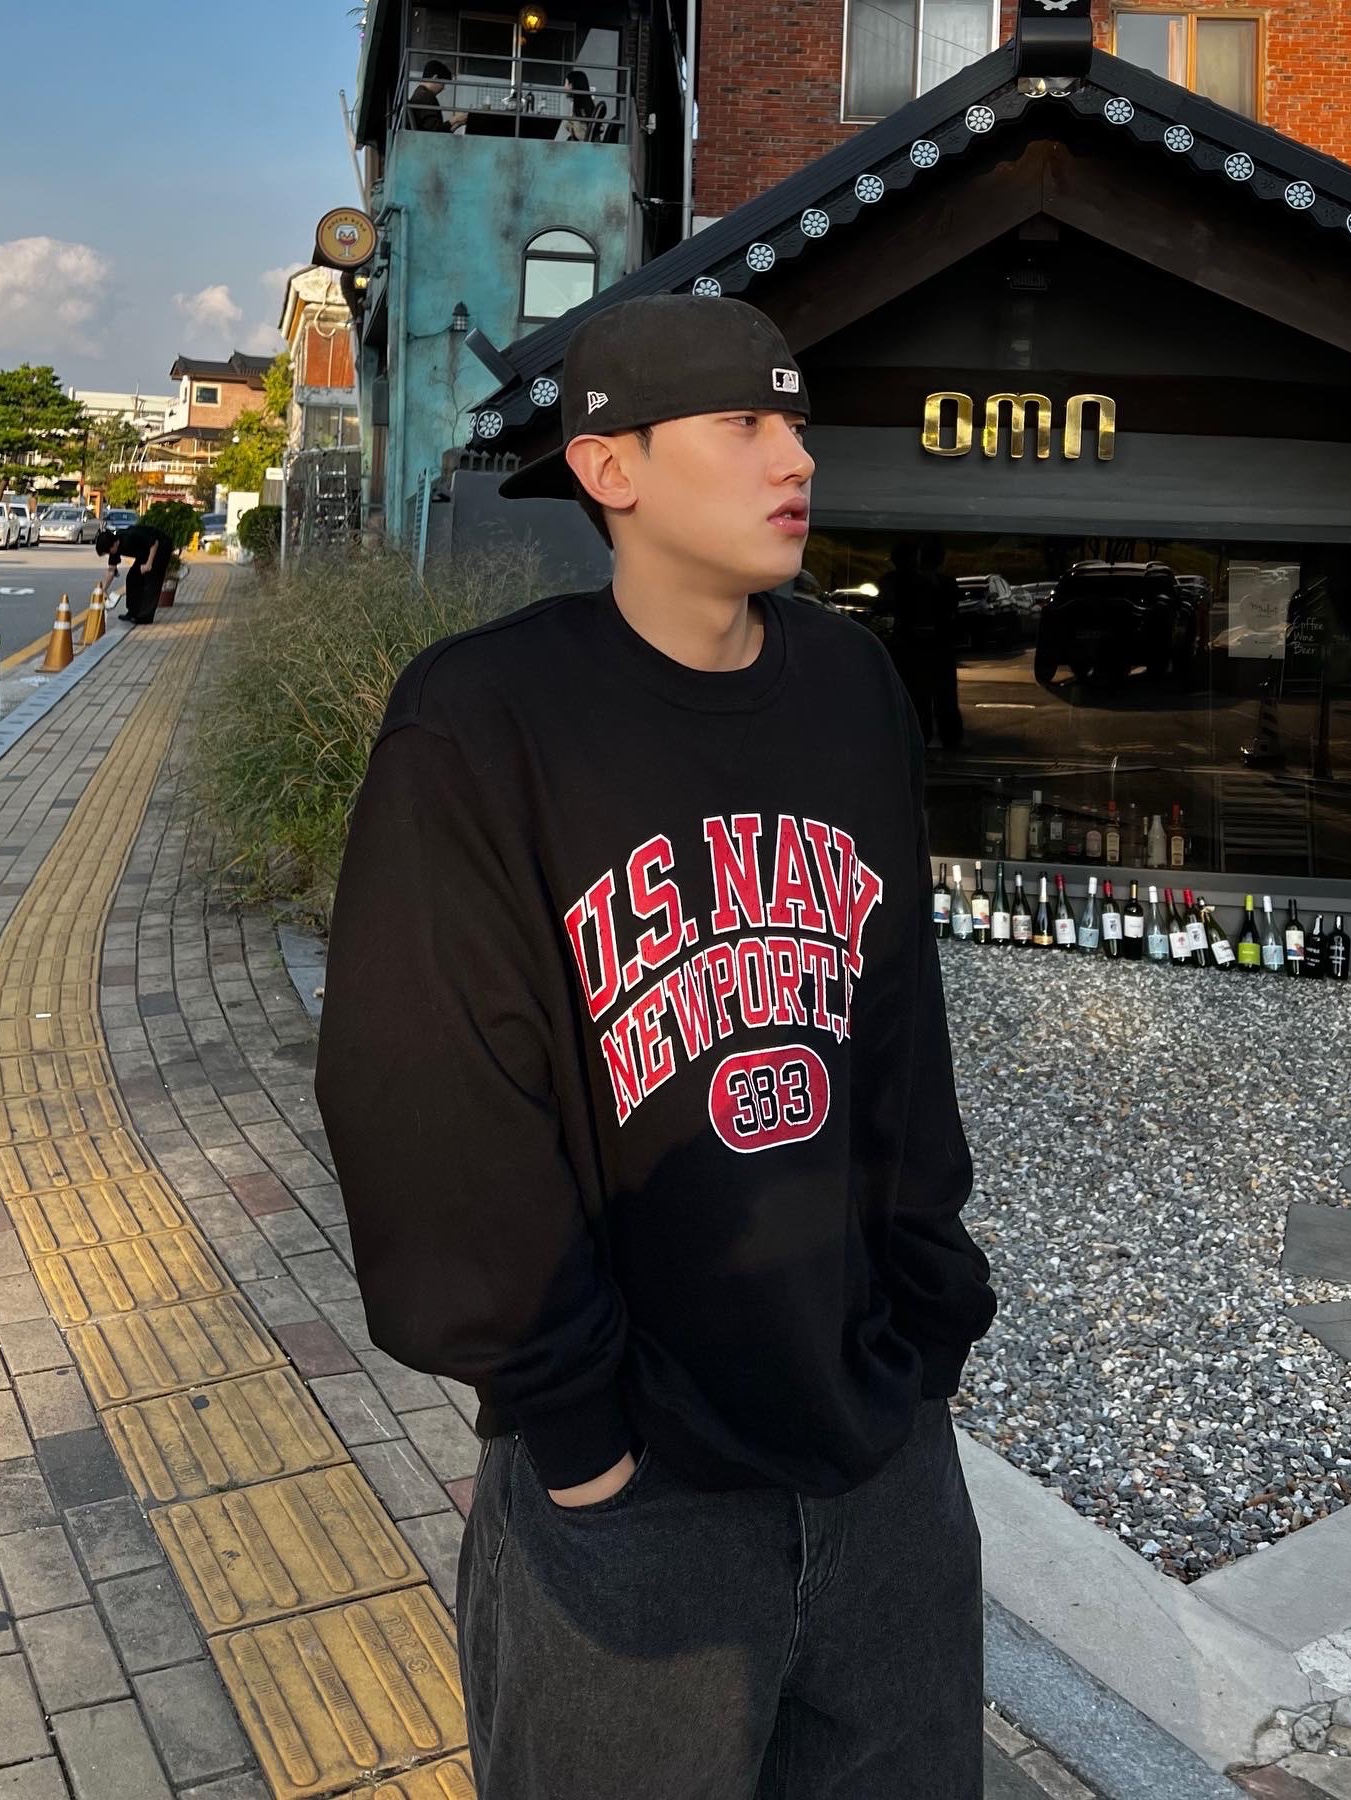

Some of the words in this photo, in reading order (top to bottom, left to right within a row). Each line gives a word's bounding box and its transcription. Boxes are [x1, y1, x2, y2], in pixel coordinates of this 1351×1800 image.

[1293, 630, 1315, 642] Wine
[564, 833, 699, 1023] U.S.
[702, 813, 884, 979] NAVY
[726, 1060, 813, 1137] 383
